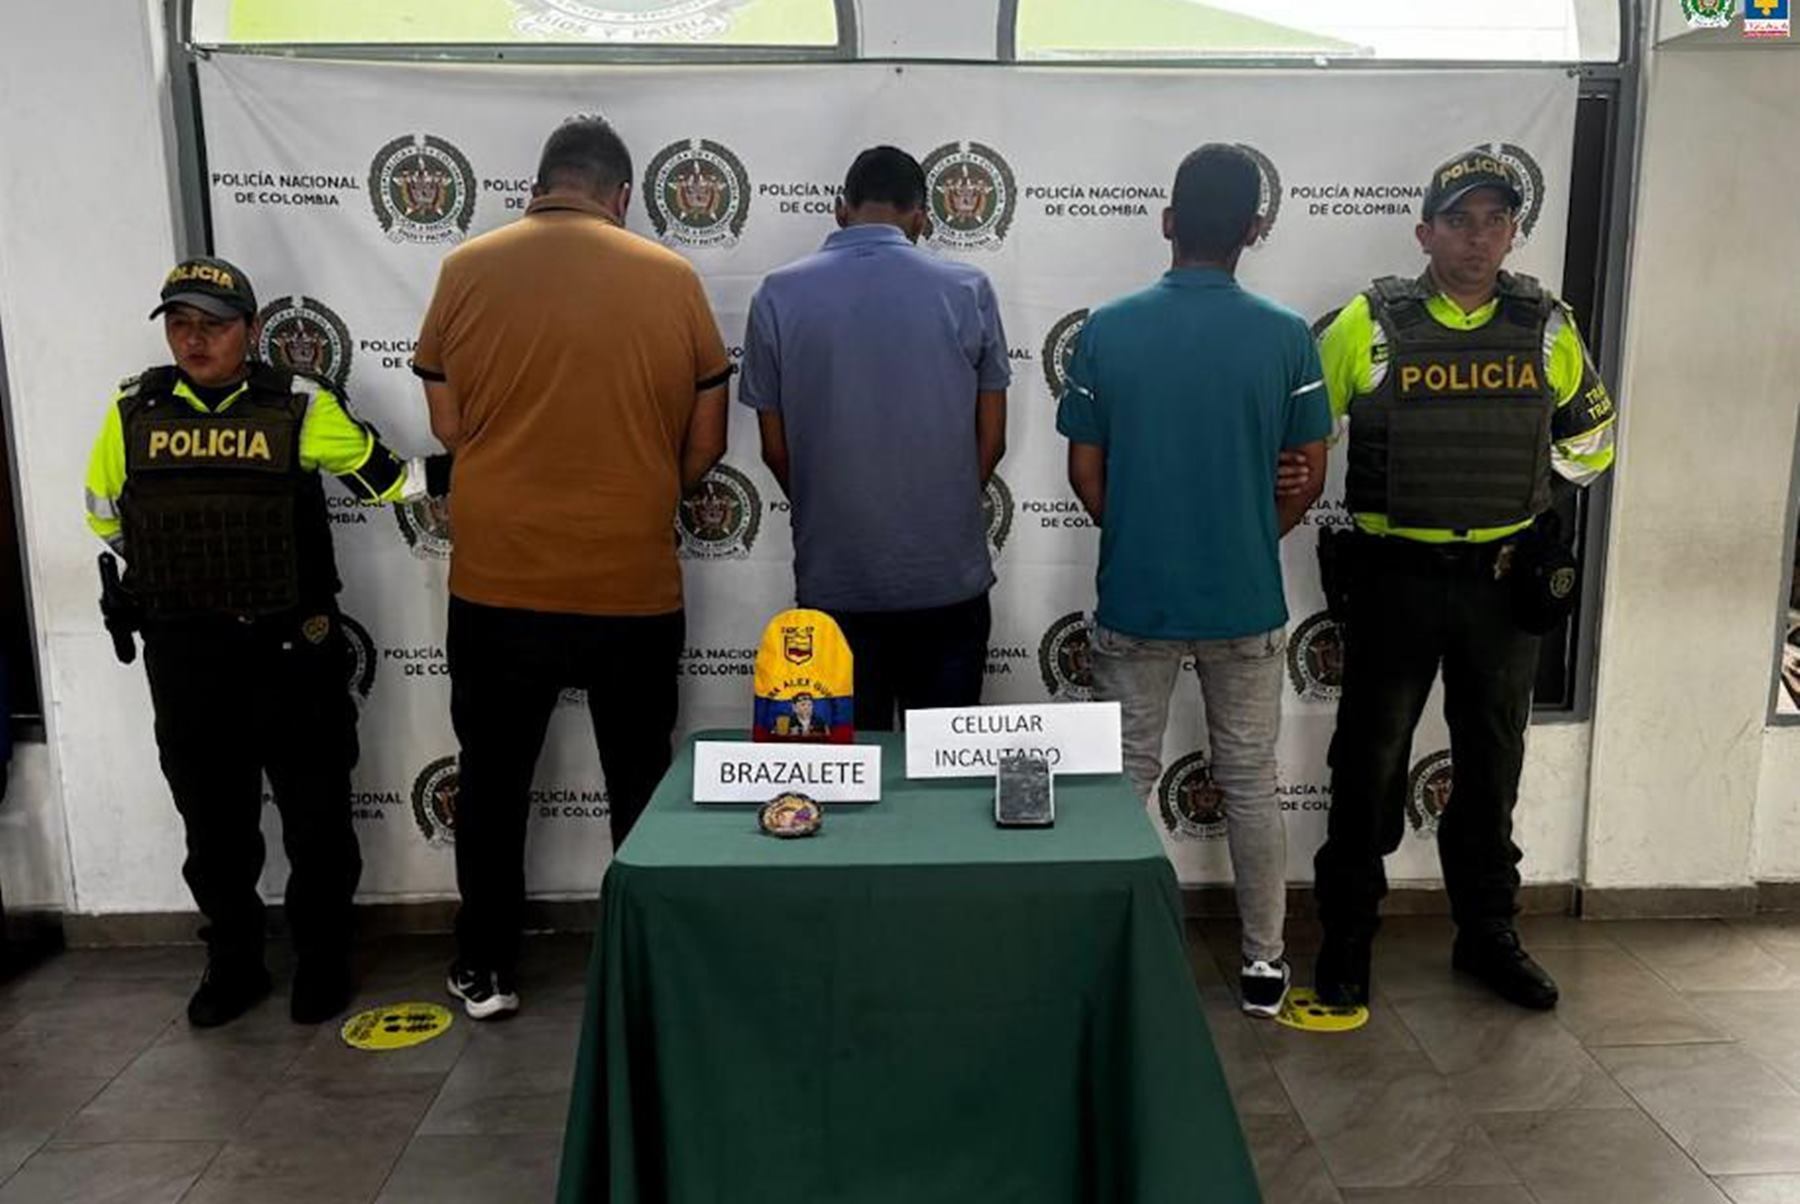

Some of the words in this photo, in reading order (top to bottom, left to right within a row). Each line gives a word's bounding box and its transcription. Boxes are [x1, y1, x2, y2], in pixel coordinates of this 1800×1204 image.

[212, 170, 275, 187] POLICÍA
[280, 174, 360, 190] NACIONAL
[483, 178, 529, 192] POLIC
[759, 182, 820, 196] POLICÍA
[1025, 184, 1085, 199] POLICÍA
[1088, 186, 1168, 199] NACIONAL
[1290, 184, 1349, 199] POLICÍA
[1353, 186, 1424, 199] NACIONA
[235, 192, 256, 204] DE
[259, 192, 340, 205] COLOMBIA
[505, 197, 525, 209] DE
[780, 201, 800, 214] DE
[1045, 204, 1066, 216] DE
[1068, 204, 1149, 216] COLOMBIA
[1309, 203, 1330, 215] DE
[1332, 203, 1412, 215] COLOMBIA
[382, 357, 404, 369] DE
[1401, 355, 1539, 392] POLICÍA
[149, 429, 271, 460] POLICIA
[1041, 517, 1059, 528] DE
[990, 647, 1029, 659] ONAL
[404, 663, 425, 676] DE
[688, 663, 755, 676] COLOMBI
[951, 714, 1044, 734] CELULAR
[720, 762, 865, 784] BRAZALETE
[1281, 801, 1298, 811] DE
